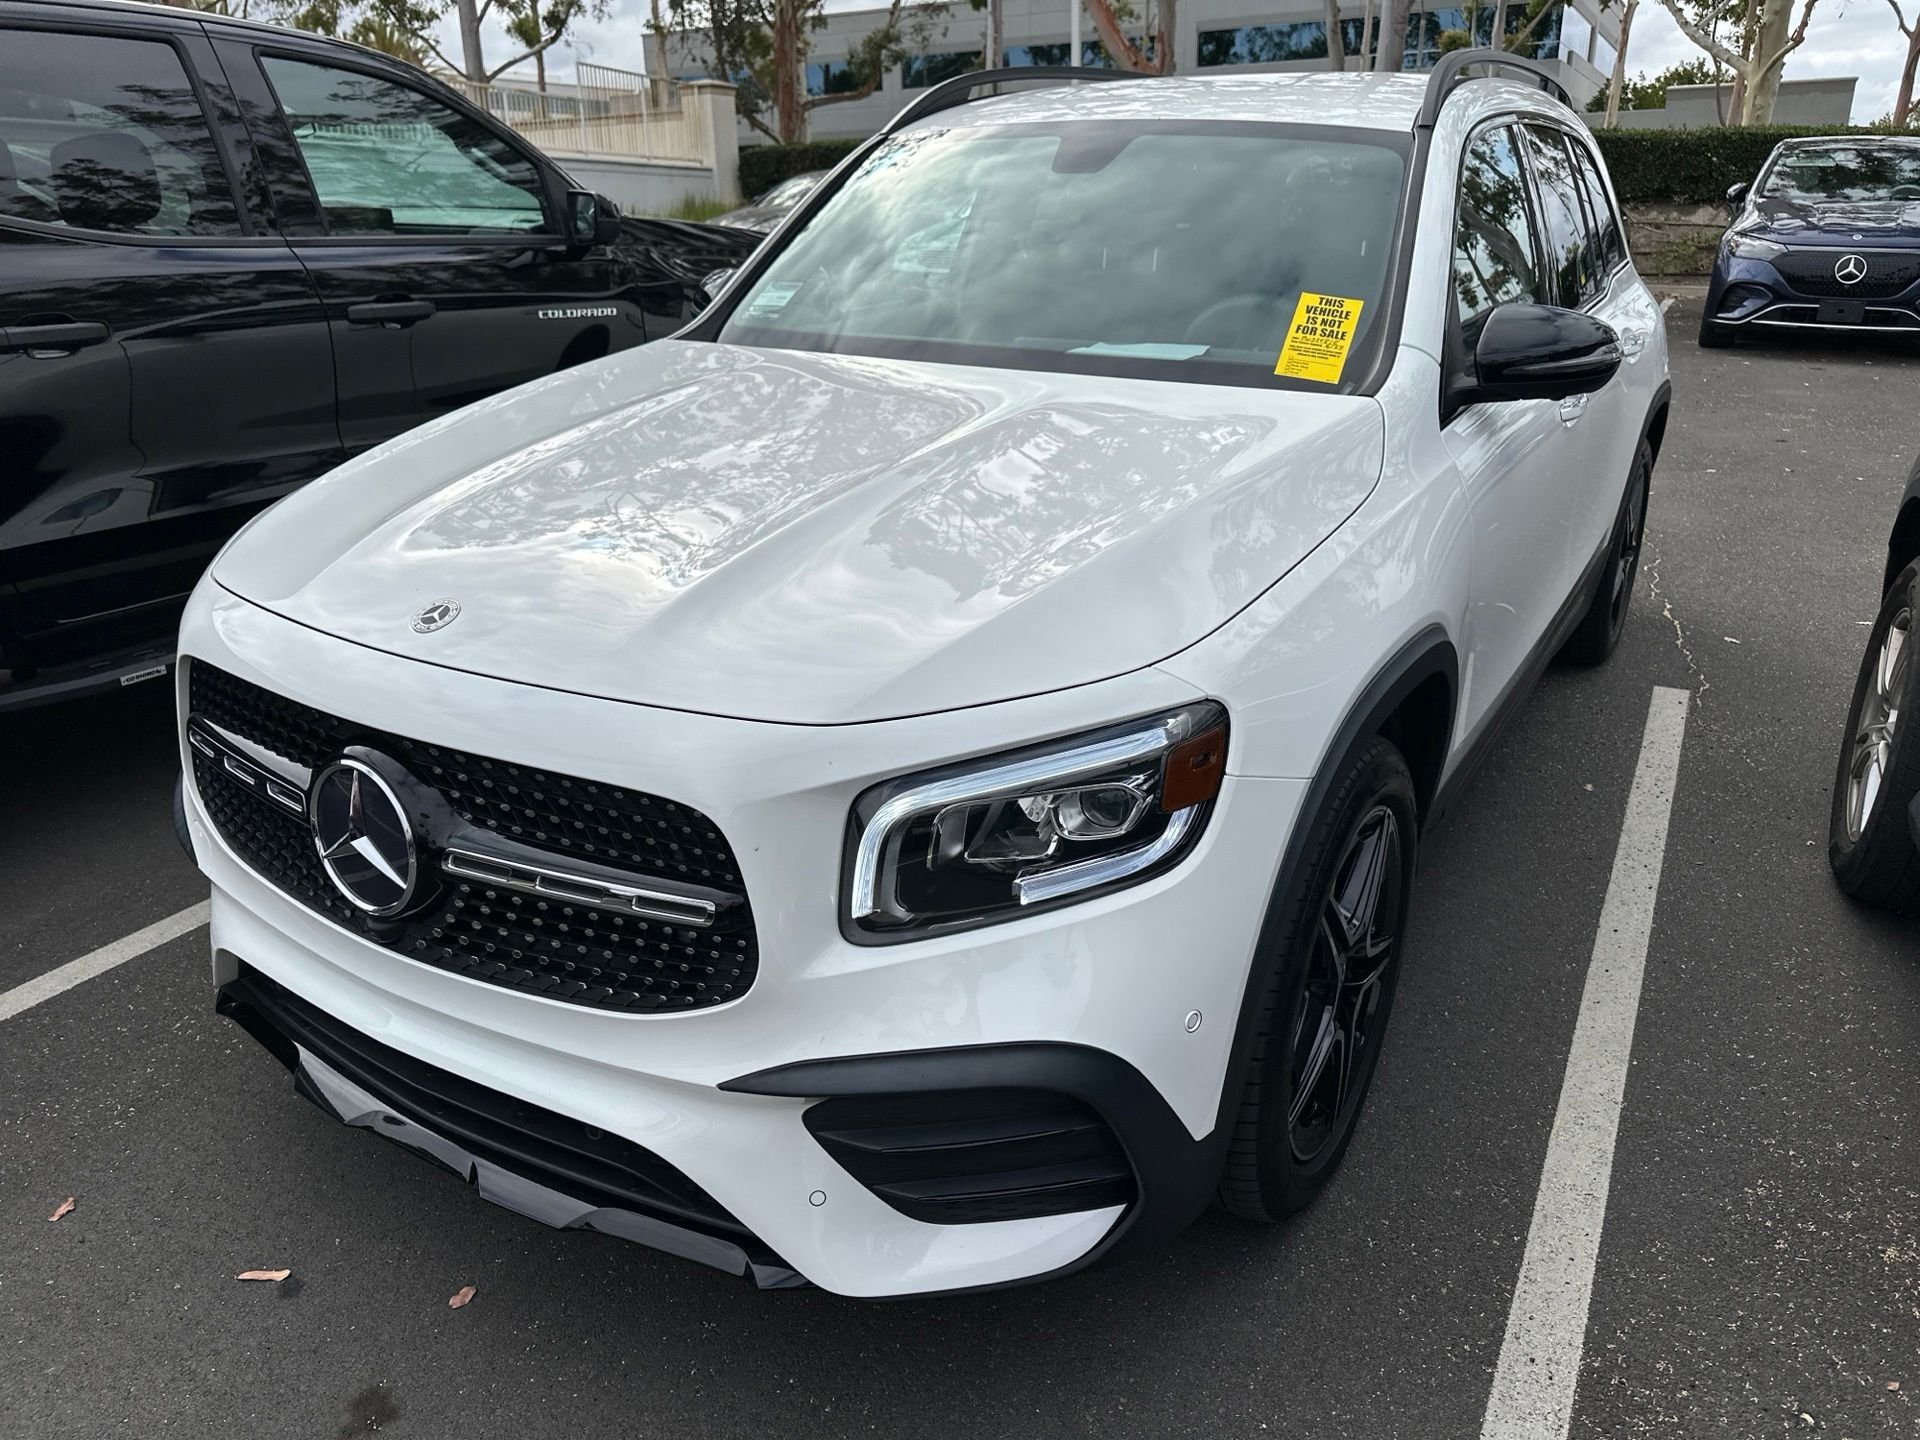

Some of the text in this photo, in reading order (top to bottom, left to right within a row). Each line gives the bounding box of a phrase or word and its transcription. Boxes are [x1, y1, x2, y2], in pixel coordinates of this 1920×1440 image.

[1319, 297, 1345, 308] THIS
[538, 307, 617, 319] COLORADO
[1305, 305, 1351, 320] VEHICLE
[1306, 316, 1344, 329] IS NOT
[1295, 325, 1347, 340] FOR SALE
